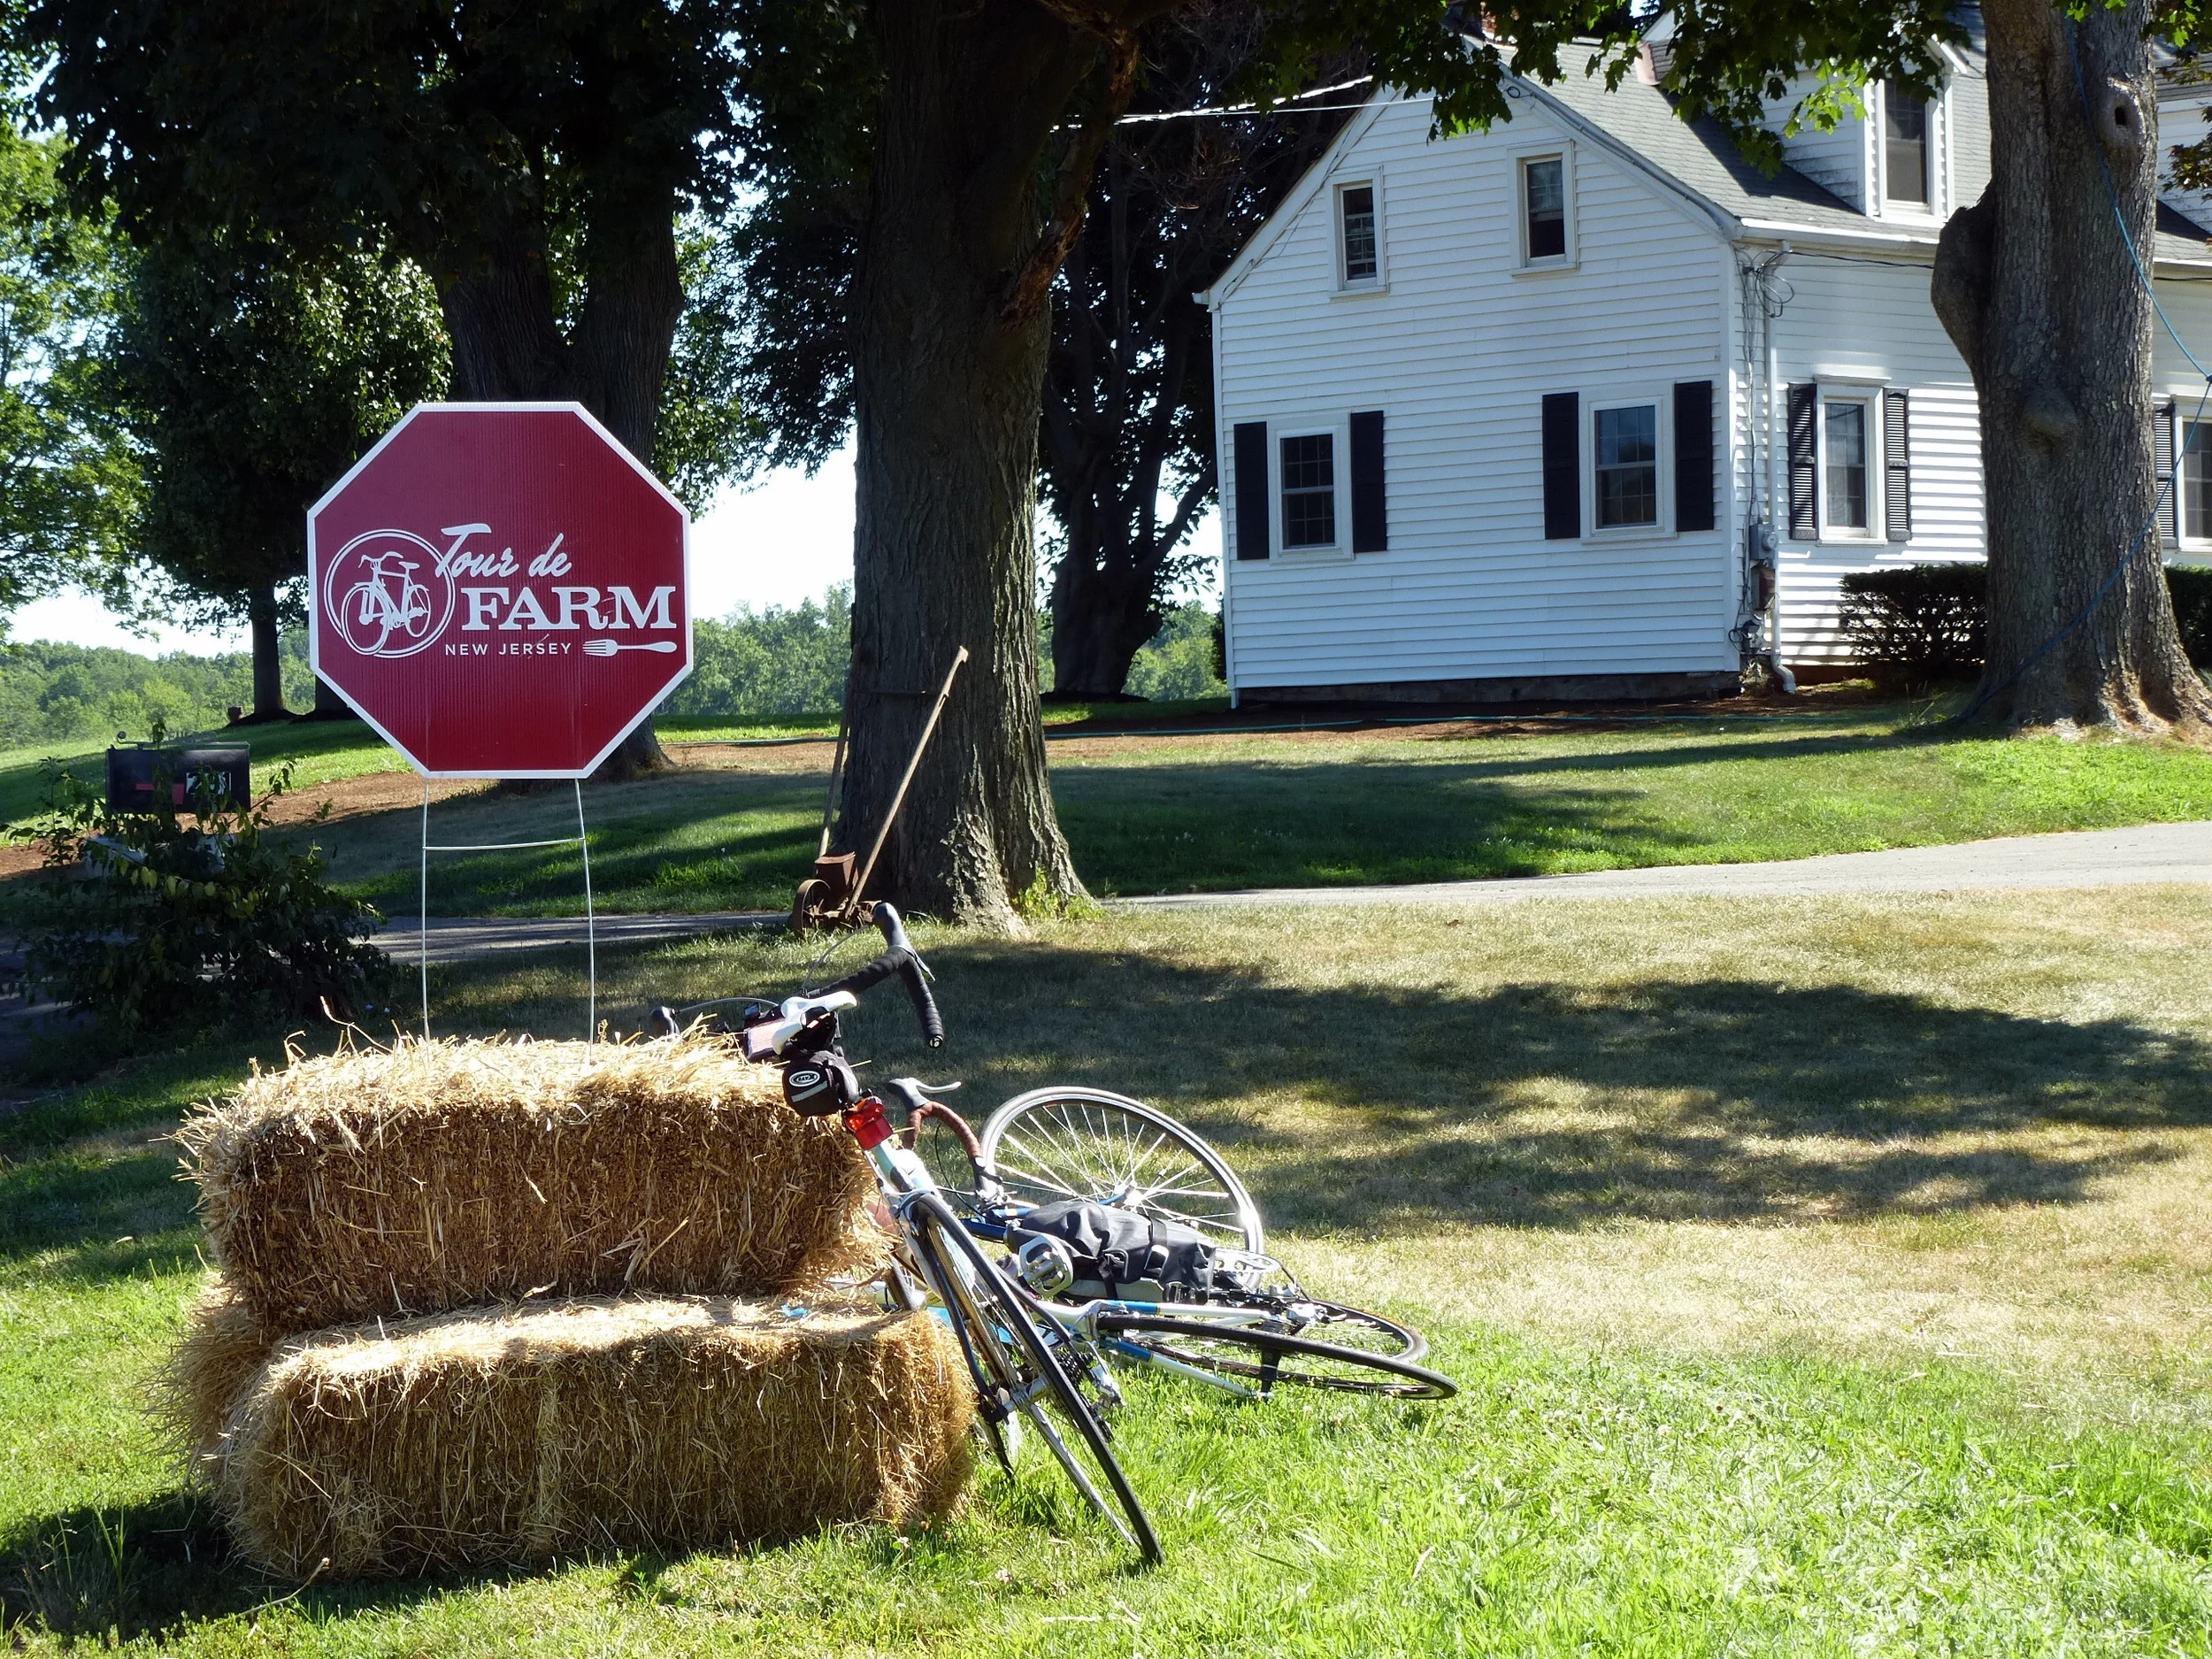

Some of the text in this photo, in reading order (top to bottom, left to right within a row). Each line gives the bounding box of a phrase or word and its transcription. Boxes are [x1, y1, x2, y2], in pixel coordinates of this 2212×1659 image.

[436, 523, 572, 577] Tour de
[461, 586, 677, 630] FARM
[445, 642, 572, 655] NEW JERSEY
